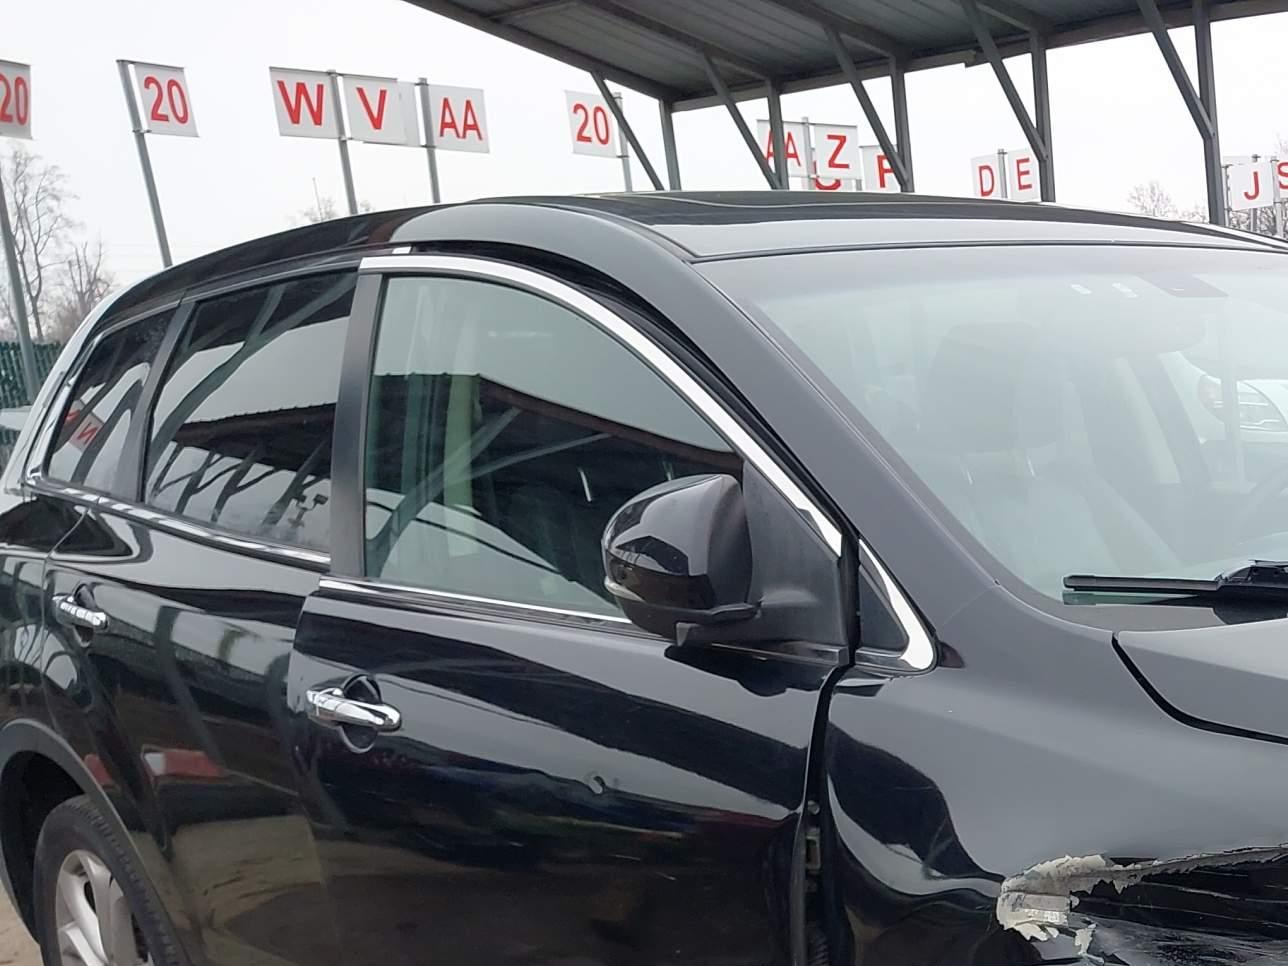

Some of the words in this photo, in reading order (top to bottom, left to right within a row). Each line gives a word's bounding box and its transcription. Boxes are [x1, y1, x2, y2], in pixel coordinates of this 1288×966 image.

[144, 76, 190, 124] 20
[278, 80, 326, 127] W
[356, 87, 388, 131] V
[439, 97, 482, 141] AA
[572, 103, 611, 145] 20
[826, 133, 850, 170] Z
[978, 164, 995, 197] D
[1016, 158, 1032, 191] E
[1243, 171, 1261, 201] J
